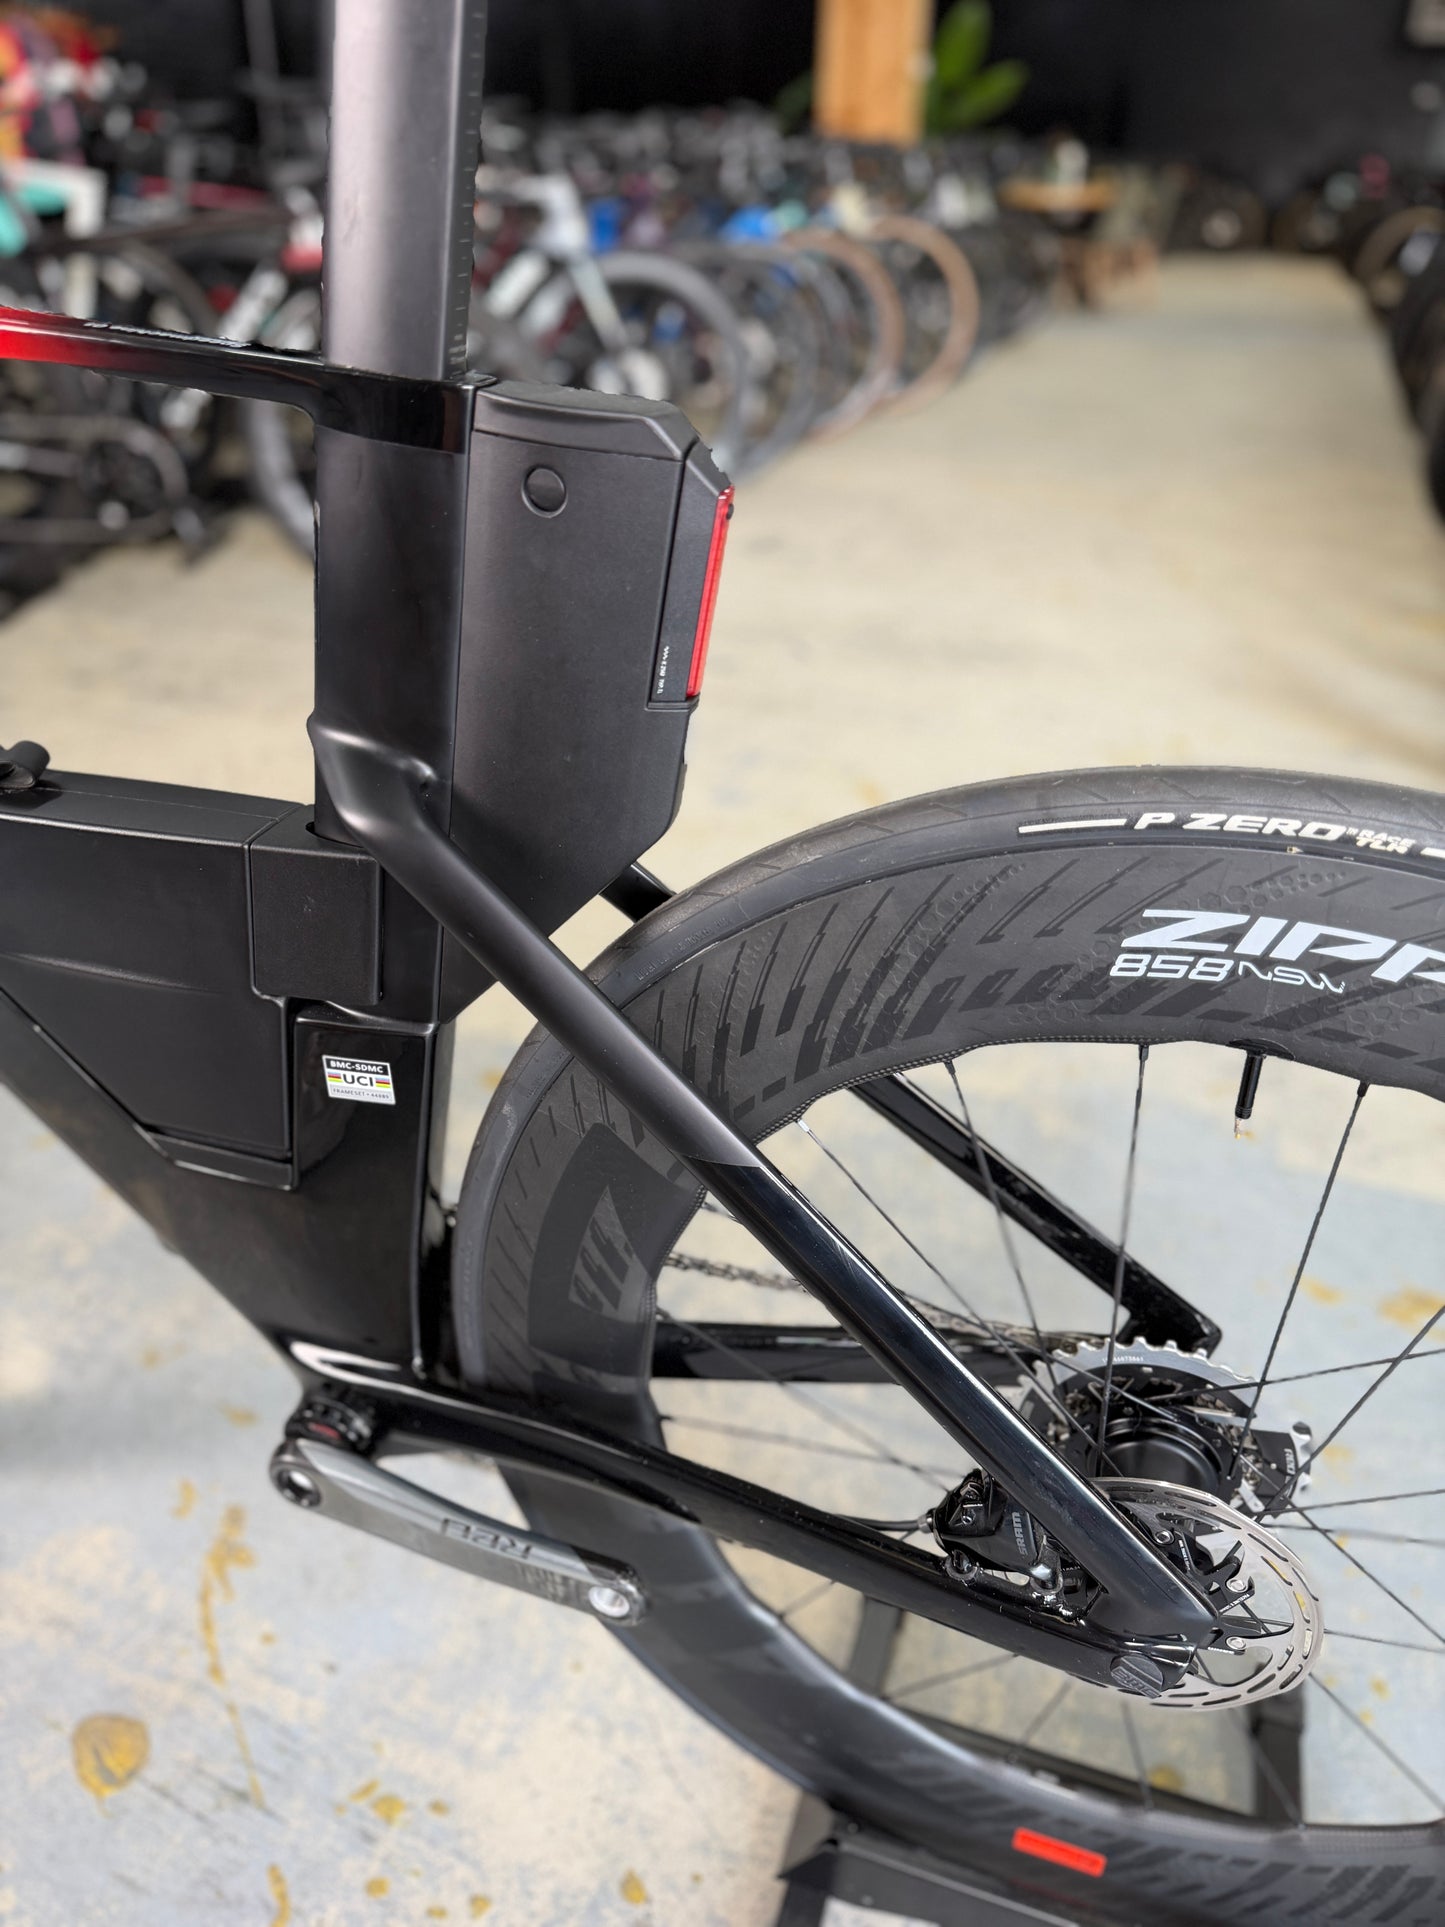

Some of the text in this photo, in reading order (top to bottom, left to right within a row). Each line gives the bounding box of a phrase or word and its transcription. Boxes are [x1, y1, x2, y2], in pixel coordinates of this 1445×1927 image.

[1134, 812, 1176, 830] P
[1182, 812, 1348, 841] ZERO
[1109, 953, 1235, 982] 858
[329, 1060, 384, 1073] BMC-SDMC
[342, 1073, 374, 1087] UCI
[333, 1088, 365, 1097] FRAMESET
[1011, 1511, 1028, 1557] SRAM
